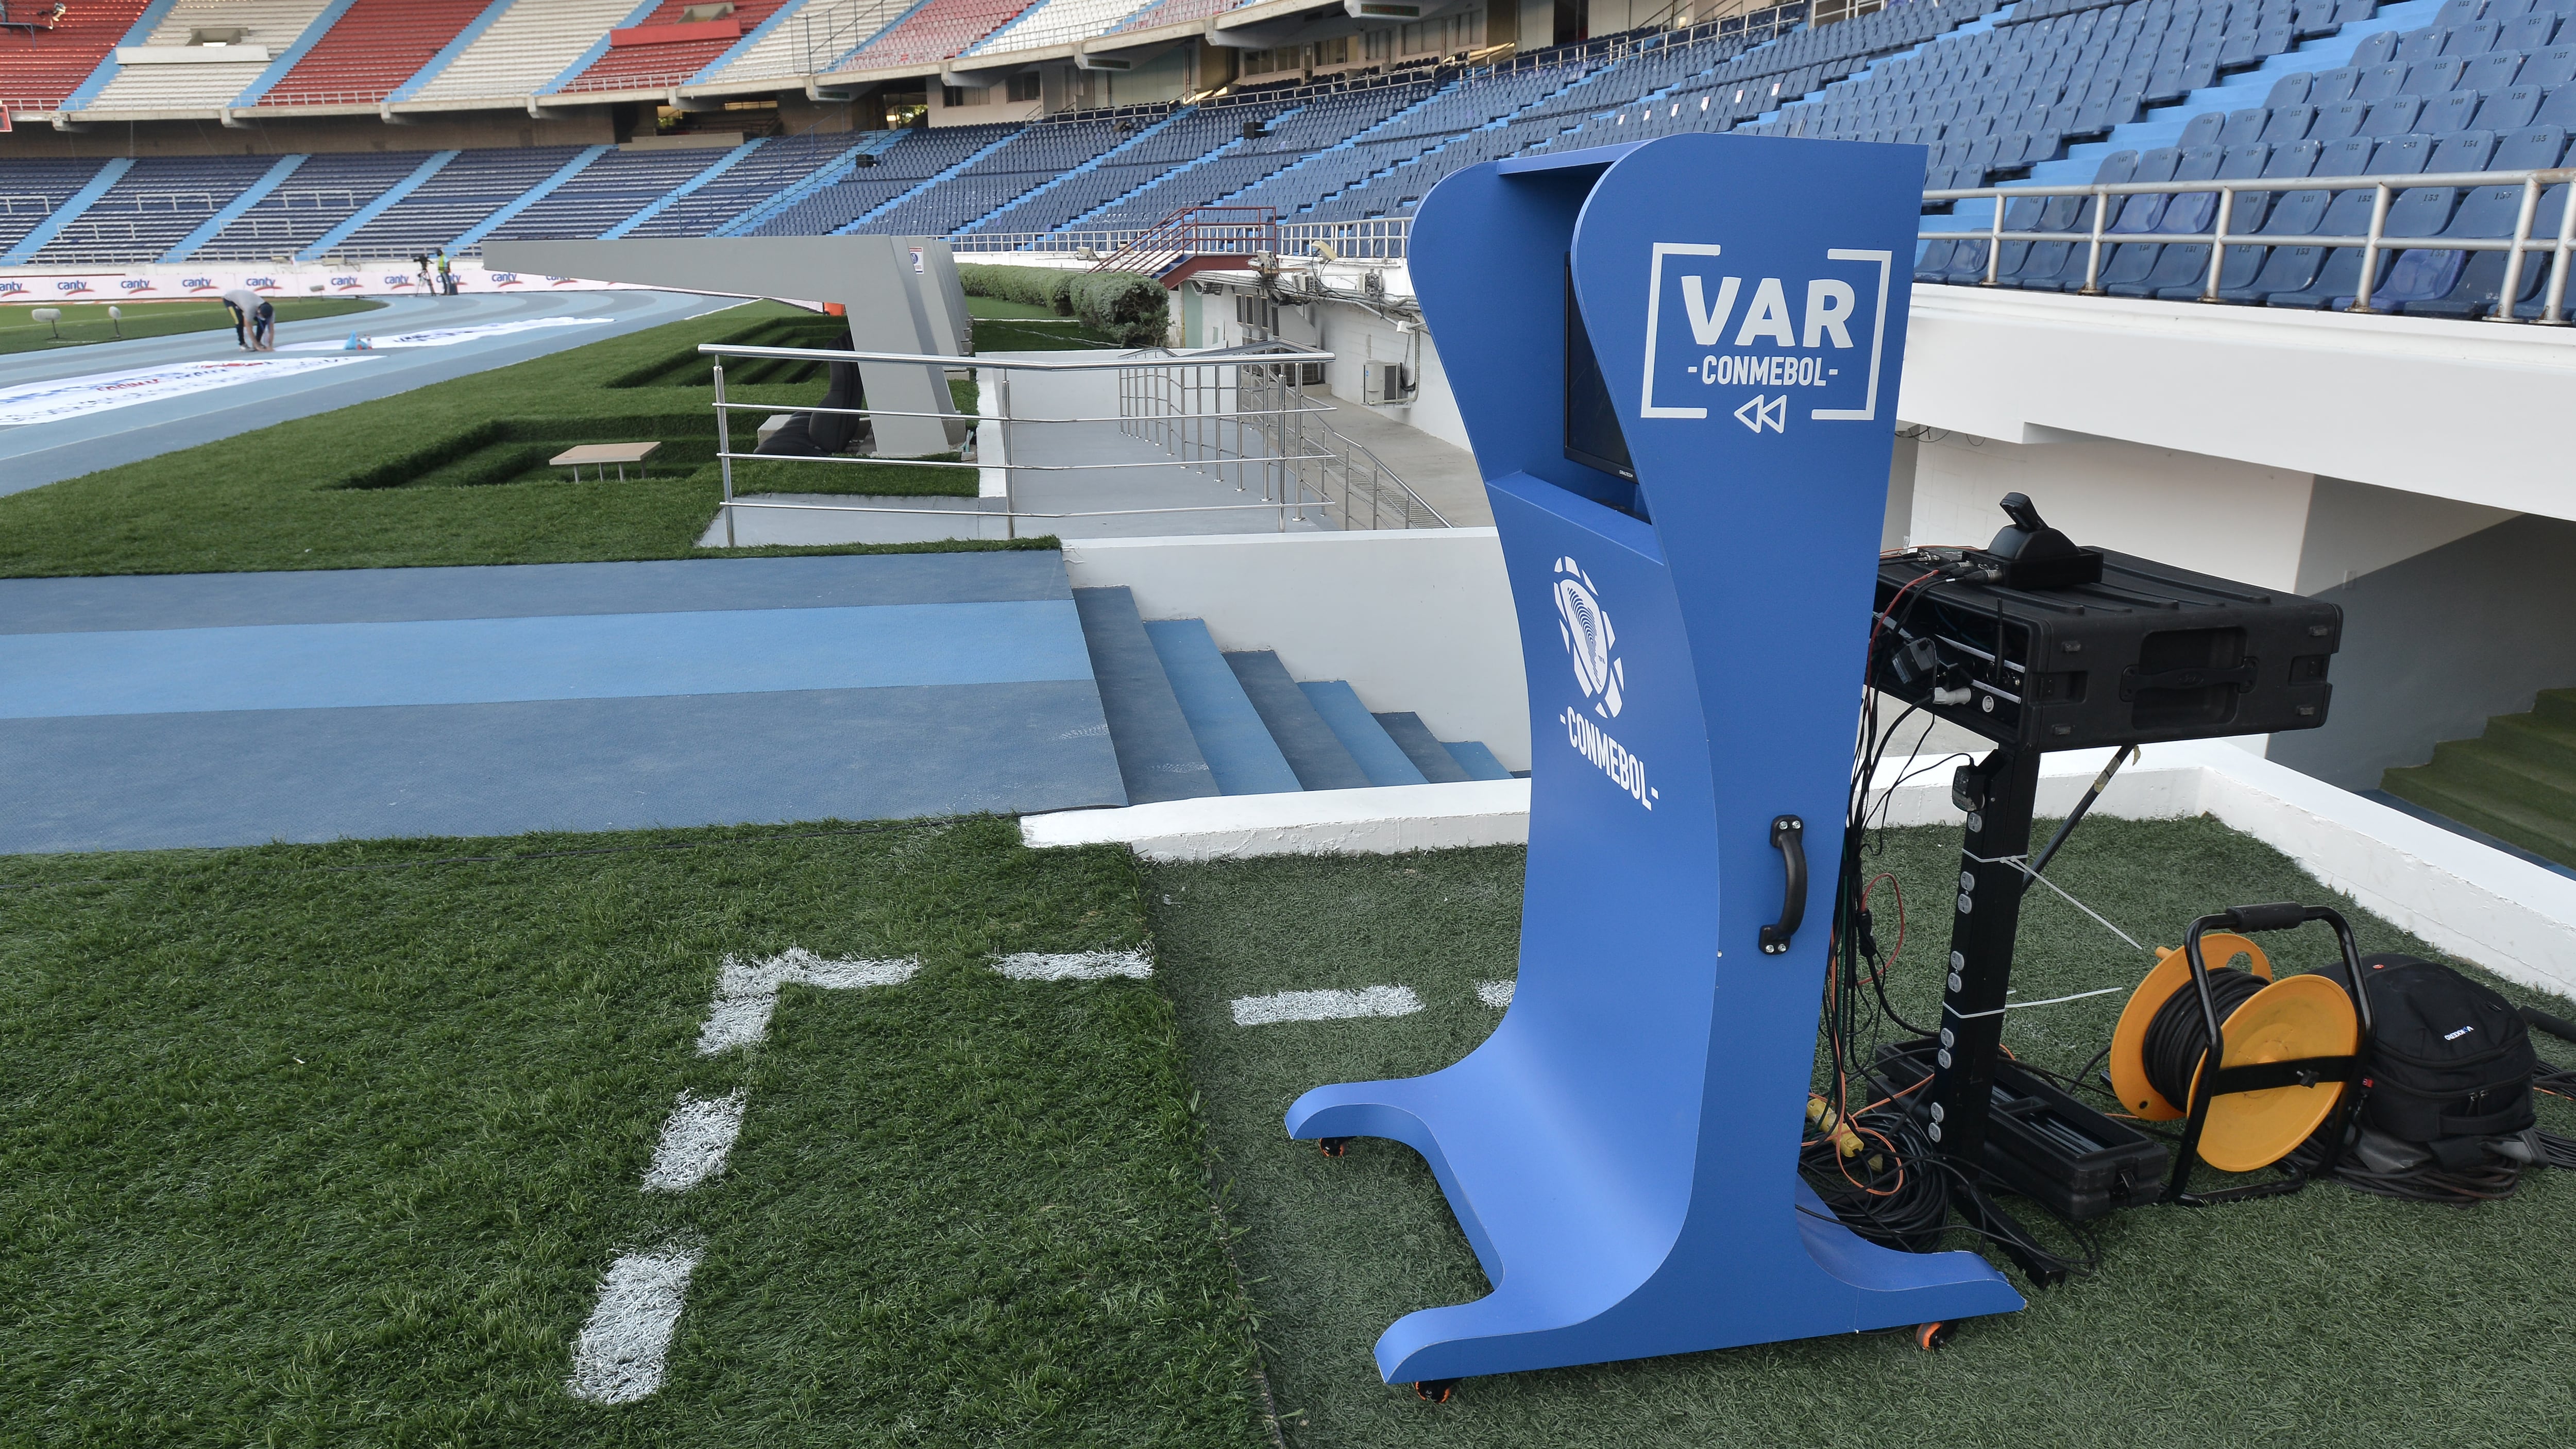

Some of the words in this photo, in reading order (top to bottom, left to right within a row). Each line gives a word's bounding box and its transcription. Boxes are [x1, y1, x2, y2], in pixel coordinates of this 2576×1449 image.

[2528, 17, 2542, 25] 157
[2531, 134, 2548, 143] 155
[246, 277, 275, 286] canty
[331, 276, 357, 285] canty
[385, 276, 409, 284] canty
[492, 273, 517, 282] canty
[0, 282, 23, 291] anty
[58, 280, 87, 290] canty
[121, 279, 149, 288] canty
[182, 278, 211, 287] canty
[1681, 275, 1856, 348] VAR
